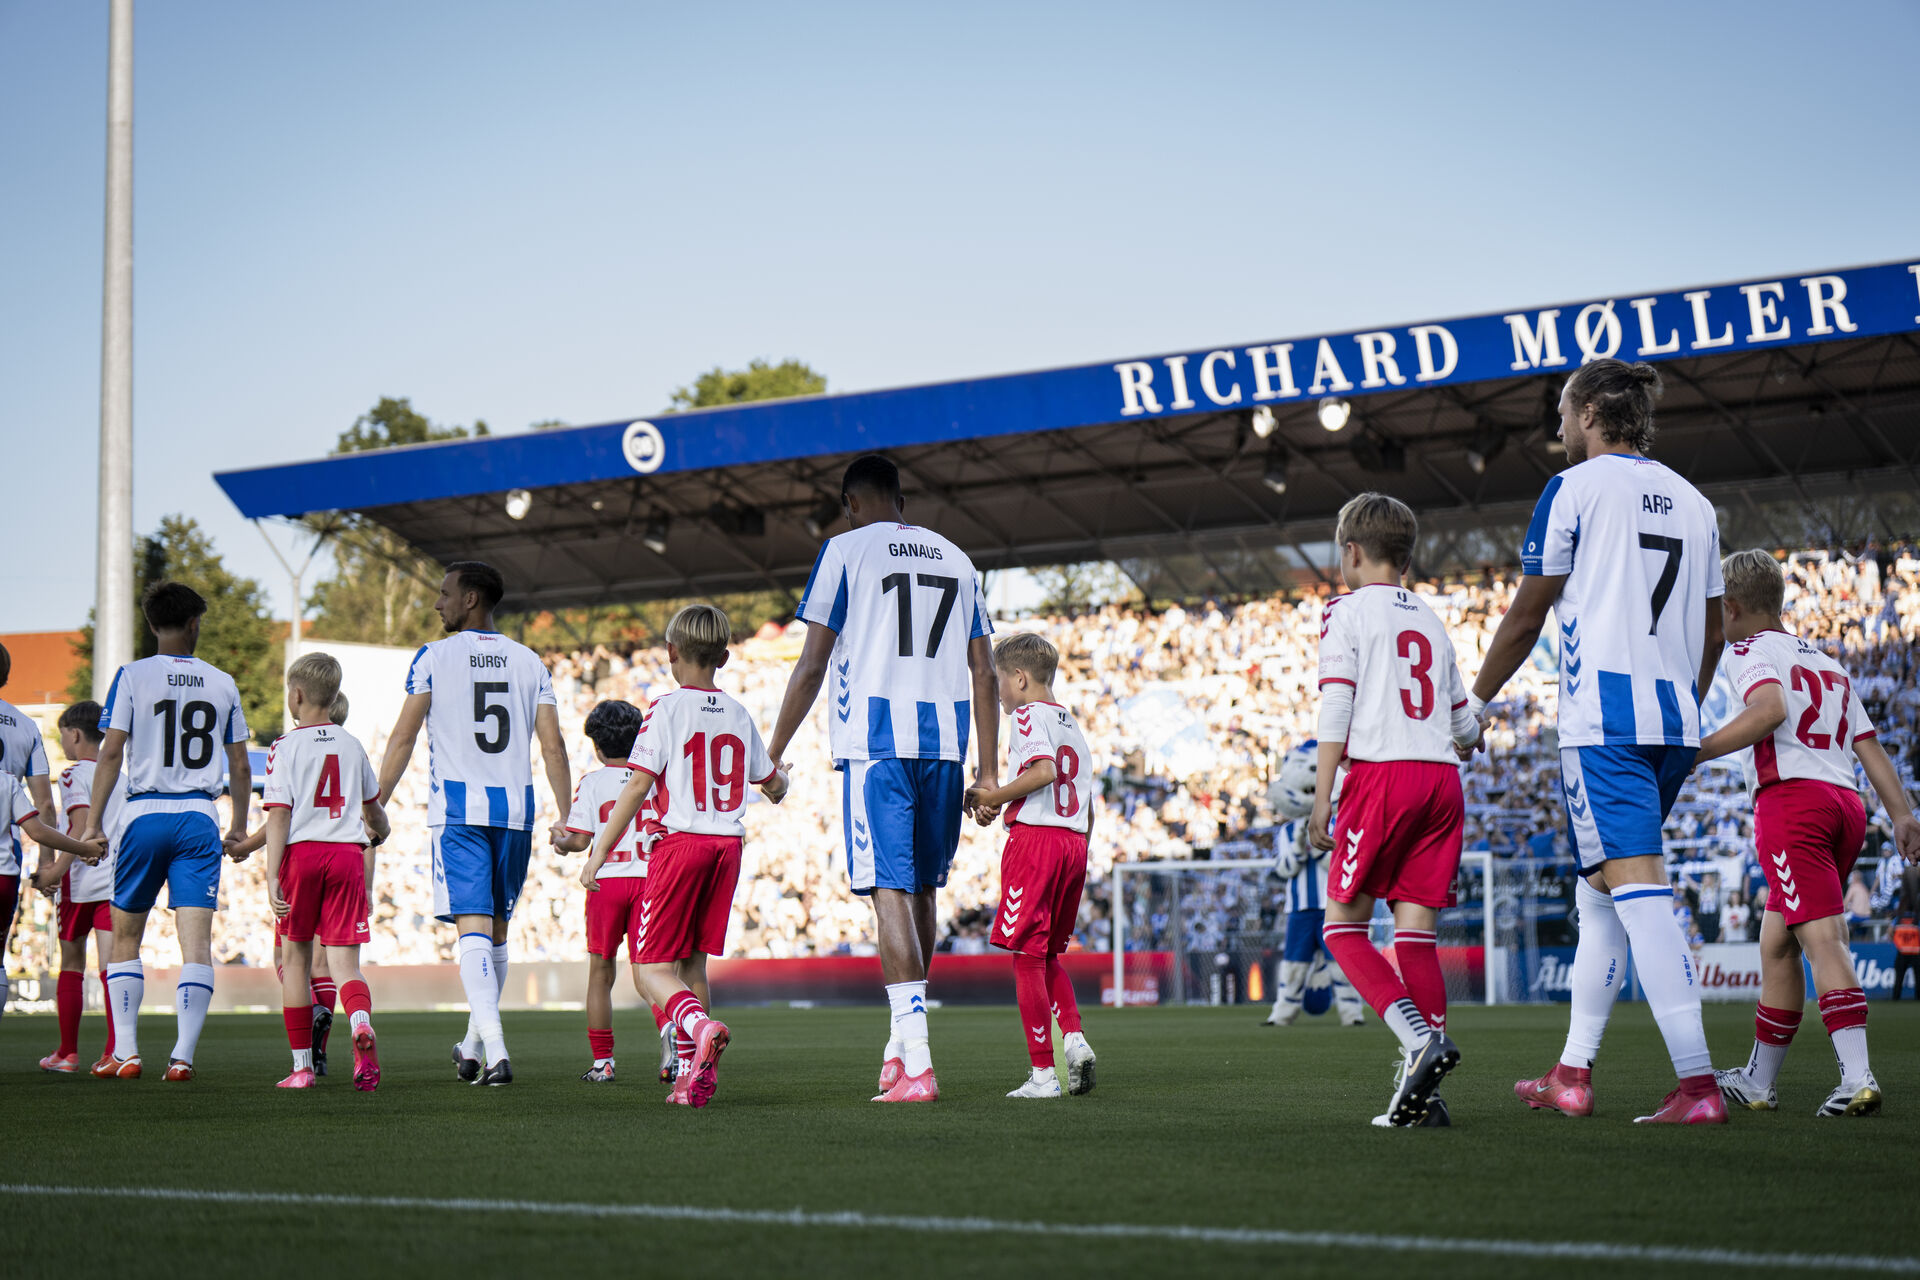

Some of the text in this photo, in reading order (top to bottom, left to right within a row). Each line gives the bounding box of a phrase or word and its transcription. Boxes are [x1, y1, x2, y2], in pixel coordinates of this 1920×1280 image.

[1113, 324, 1459, 416] RICHARD
[1503, 274, 1858, 371] MØLLER
[1642, 493, 1673, 515] ARP
[888, 542, 943, 560] GANAUS
[1392, 601, 1419, 612] unisport
[1638, 531, 1683, 636] 7
[881, 573, 959, 659] 17
[167, 673, 204, 688] EJDUM
[470, 653, 508, 668] BÜRGY
[1396, 629, 1435, 721] 3
[0, 713, 17, 728] SEN
[473, 681, 511, 754] 5
[700, 705, 725, 714] unisport
[1790, 664, 1851, 752] 27
[154, 699, 217, 770] 18
[313, 736, 336, 744] unisport
[313, 754, 346, 819] 4
[684, 731, 746, 813] 19
[1053, 744, 1079, 818] 8
[1604, 958, 1617, 988] 1887
[1682, 954, 1693, 986] 1887
